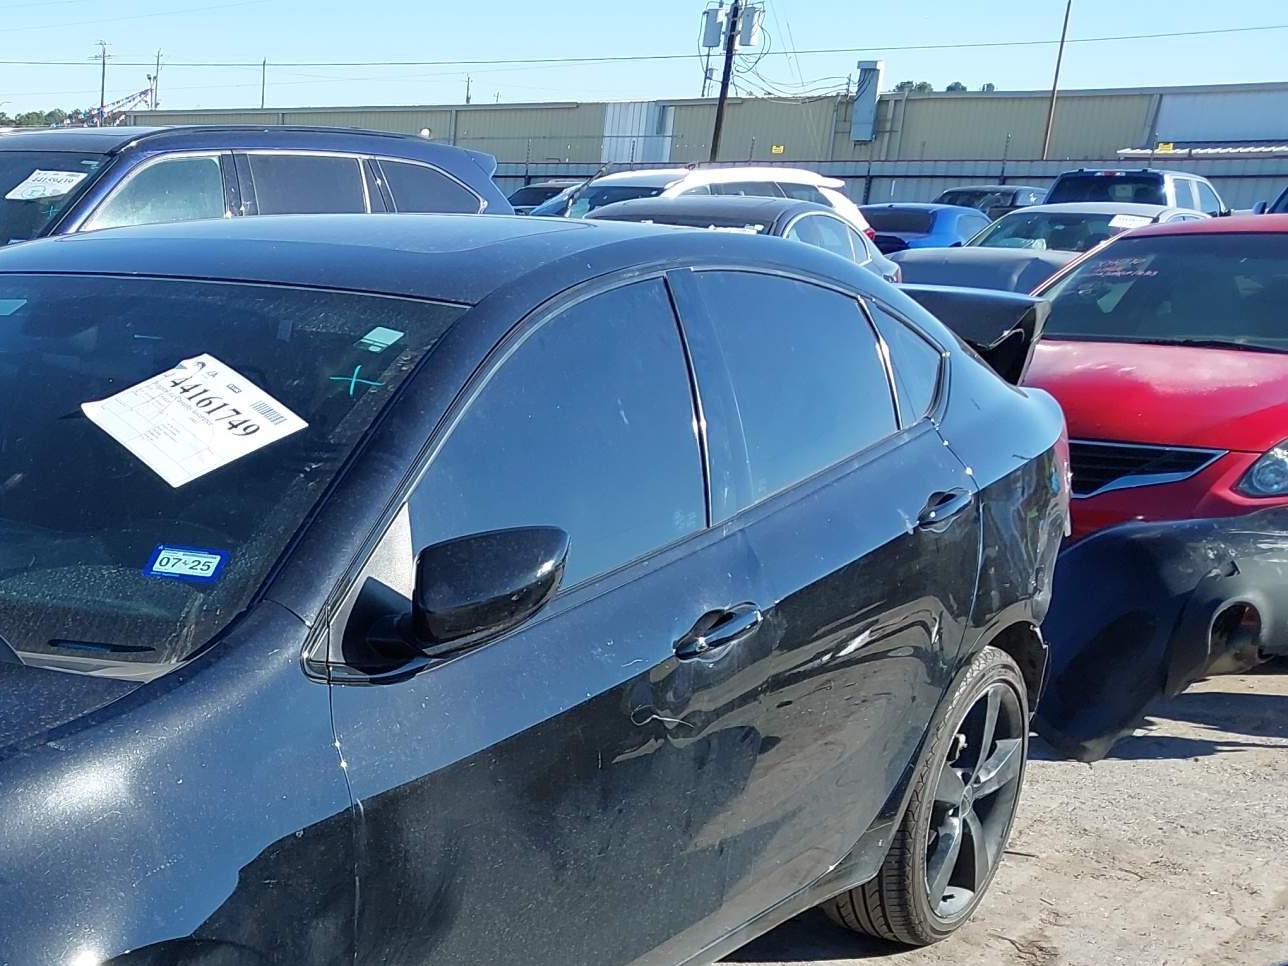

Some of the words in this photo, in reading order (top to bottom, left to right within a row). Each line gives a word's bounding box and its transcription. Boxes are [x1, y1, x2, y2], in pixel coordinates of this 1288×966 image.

[169, 375, 261, 437] 44161749
[158, 556, 182, 568] 07
[188, 559, 213, 572] 25
